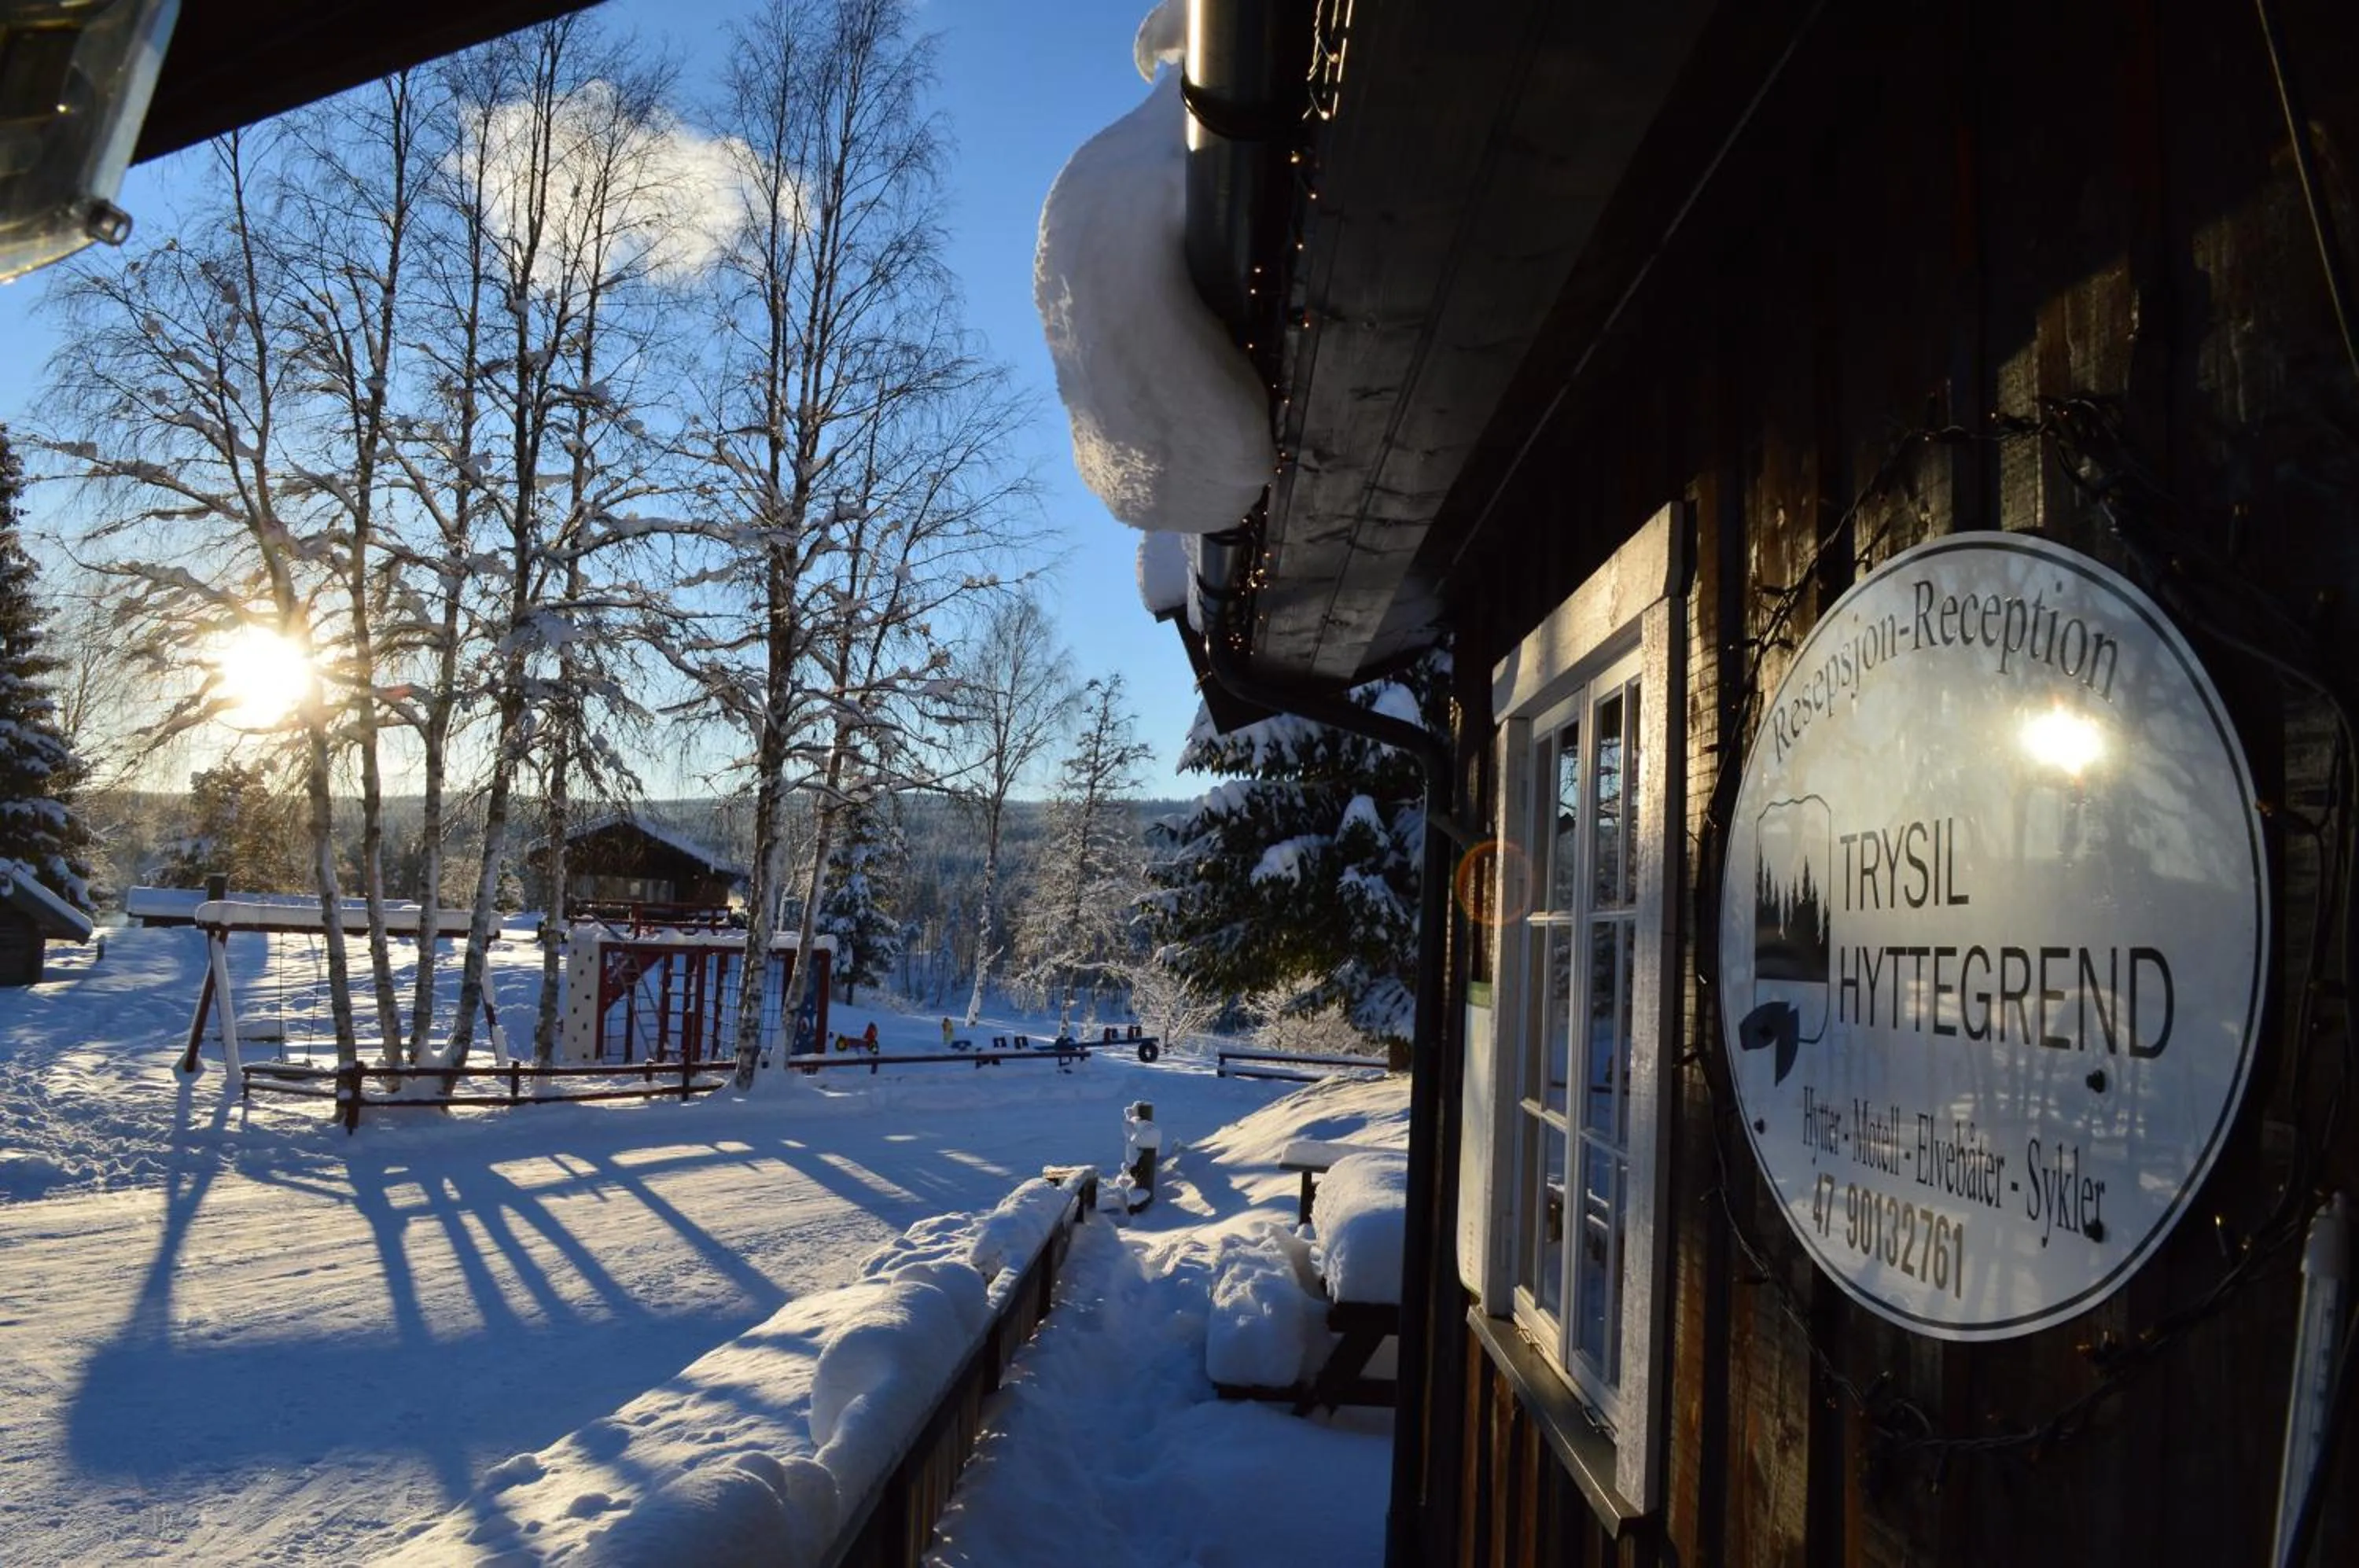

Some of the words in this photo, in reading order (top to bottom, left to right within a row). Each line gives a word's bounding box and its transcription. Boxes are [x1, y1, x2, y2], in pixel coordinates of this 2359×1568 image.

[1772, 580, 2119, 764] Resepsjon-Reception
[1839, 817, 1970, 912] TRYSIL
[1839, 945, 2175, 1060] HYTTEGREND
[1803, 1085, 1842, 1165] Hytter
[1853, 1097, 1900, 1176] Motell
[1916, 1112, 2005, 1209] Elvebåter
[2026, 1138, 2106, 1249] Sykler
[1812, 1172, 1836, 1239] 47
[1846, 1182, 1964, 1300] 90132761
